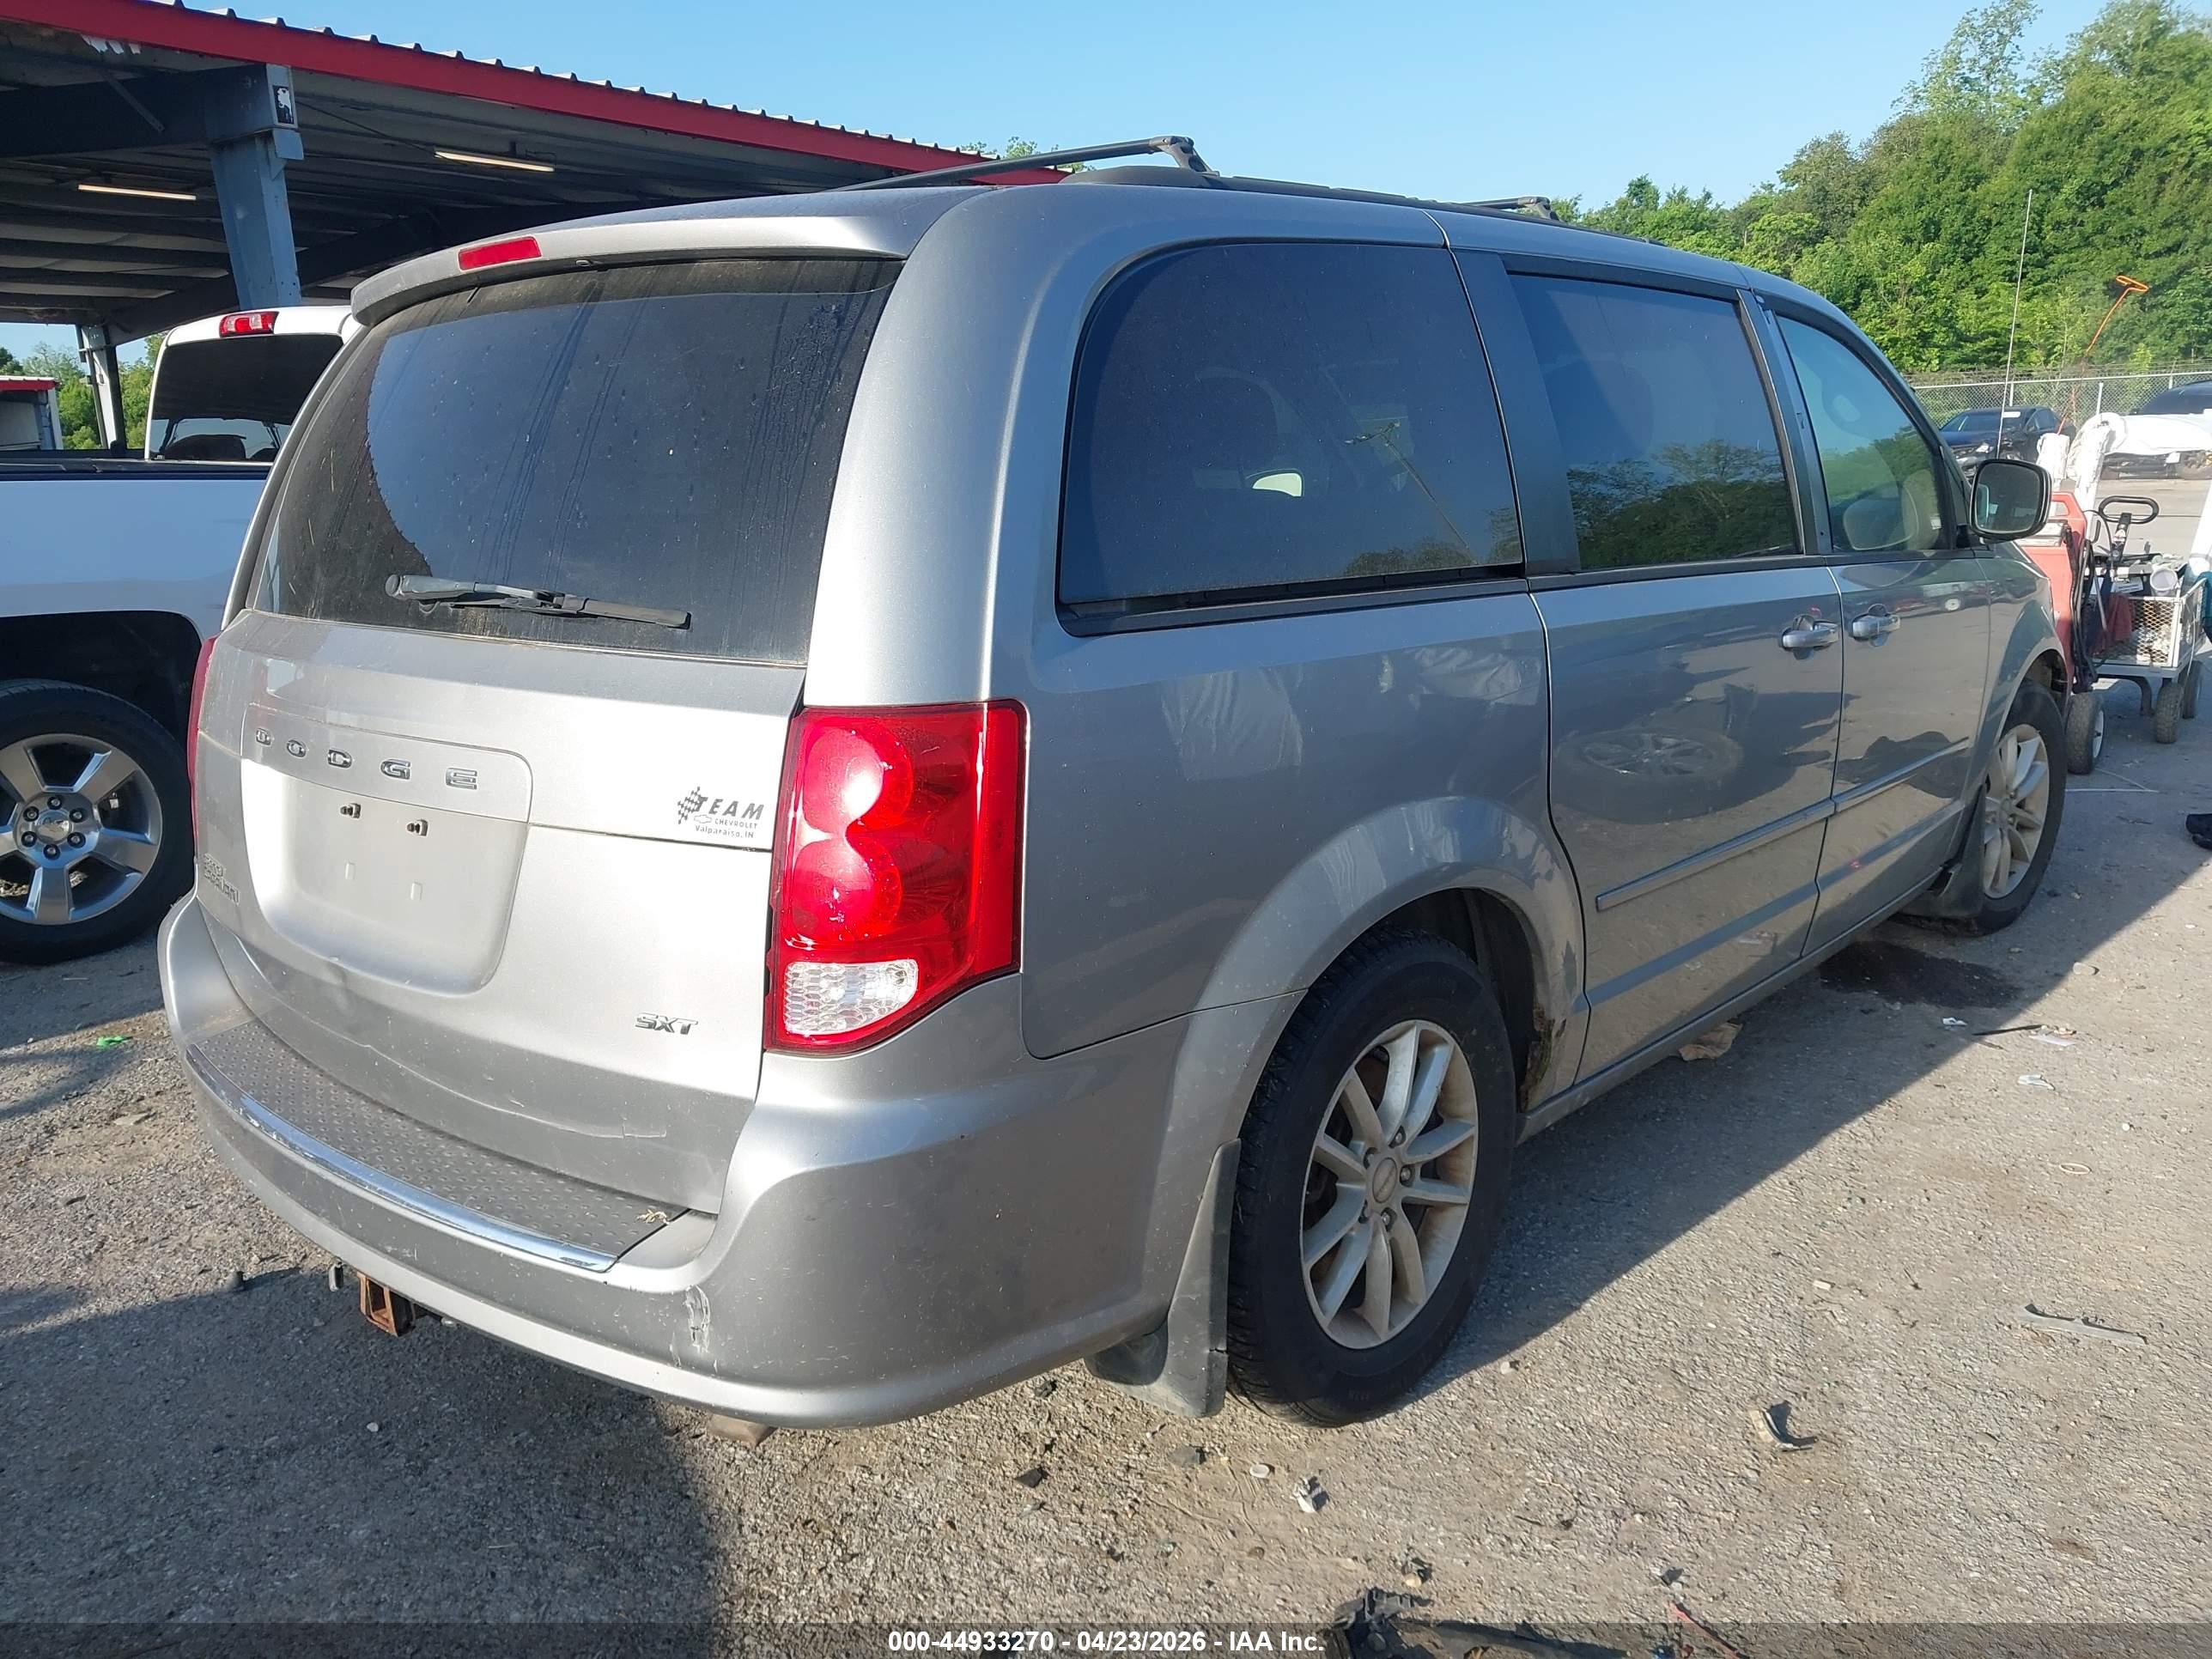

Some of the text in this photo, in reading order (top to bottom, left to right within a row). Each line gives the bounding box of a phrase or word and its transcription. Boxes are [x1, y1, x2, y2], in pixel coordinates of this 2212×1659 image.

[256, 728, 477, 789] DODGE
[696, 795, 764, 820] TEAM
[714, 818, 757, 829] CHEVROLET
[635, 1012, 699, 1036] SXT
